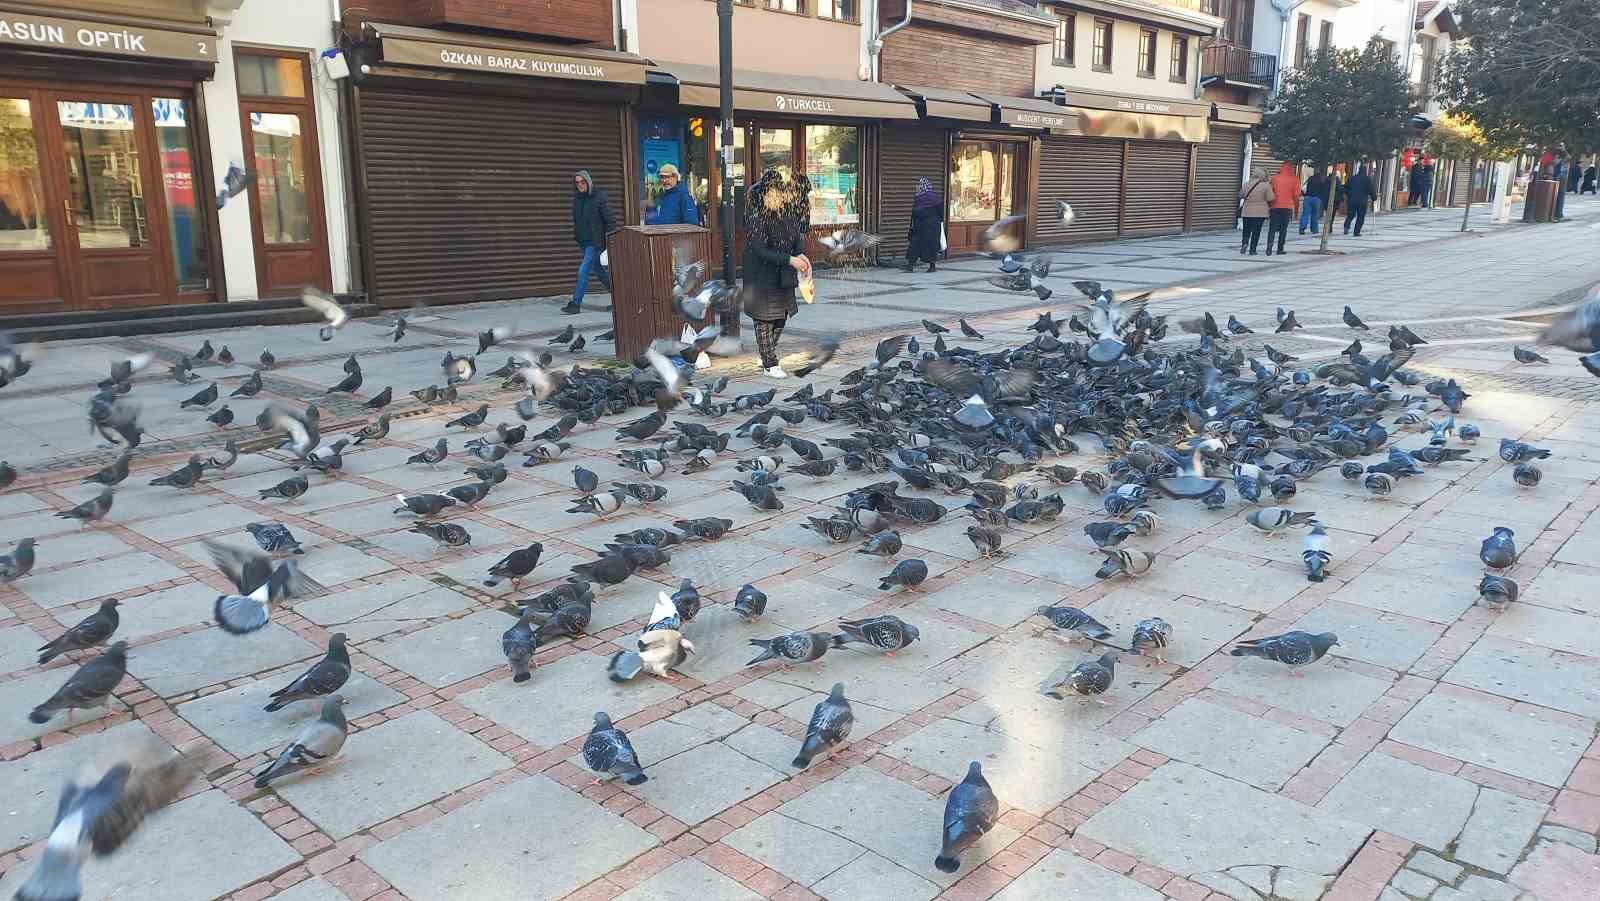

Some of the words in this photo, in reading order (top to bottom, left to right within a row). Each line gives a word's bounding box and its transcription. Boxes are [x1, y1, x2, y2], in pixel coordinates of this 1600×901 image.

[77, 29, 146, 51] OPTİK
[198, 43, 207, 54] 2
[441, 50, 481, 65] ÖZKAN
[488, 56, 527, 70] BARAZ
[532, 61, 604, 77] KUYUMCULUK
